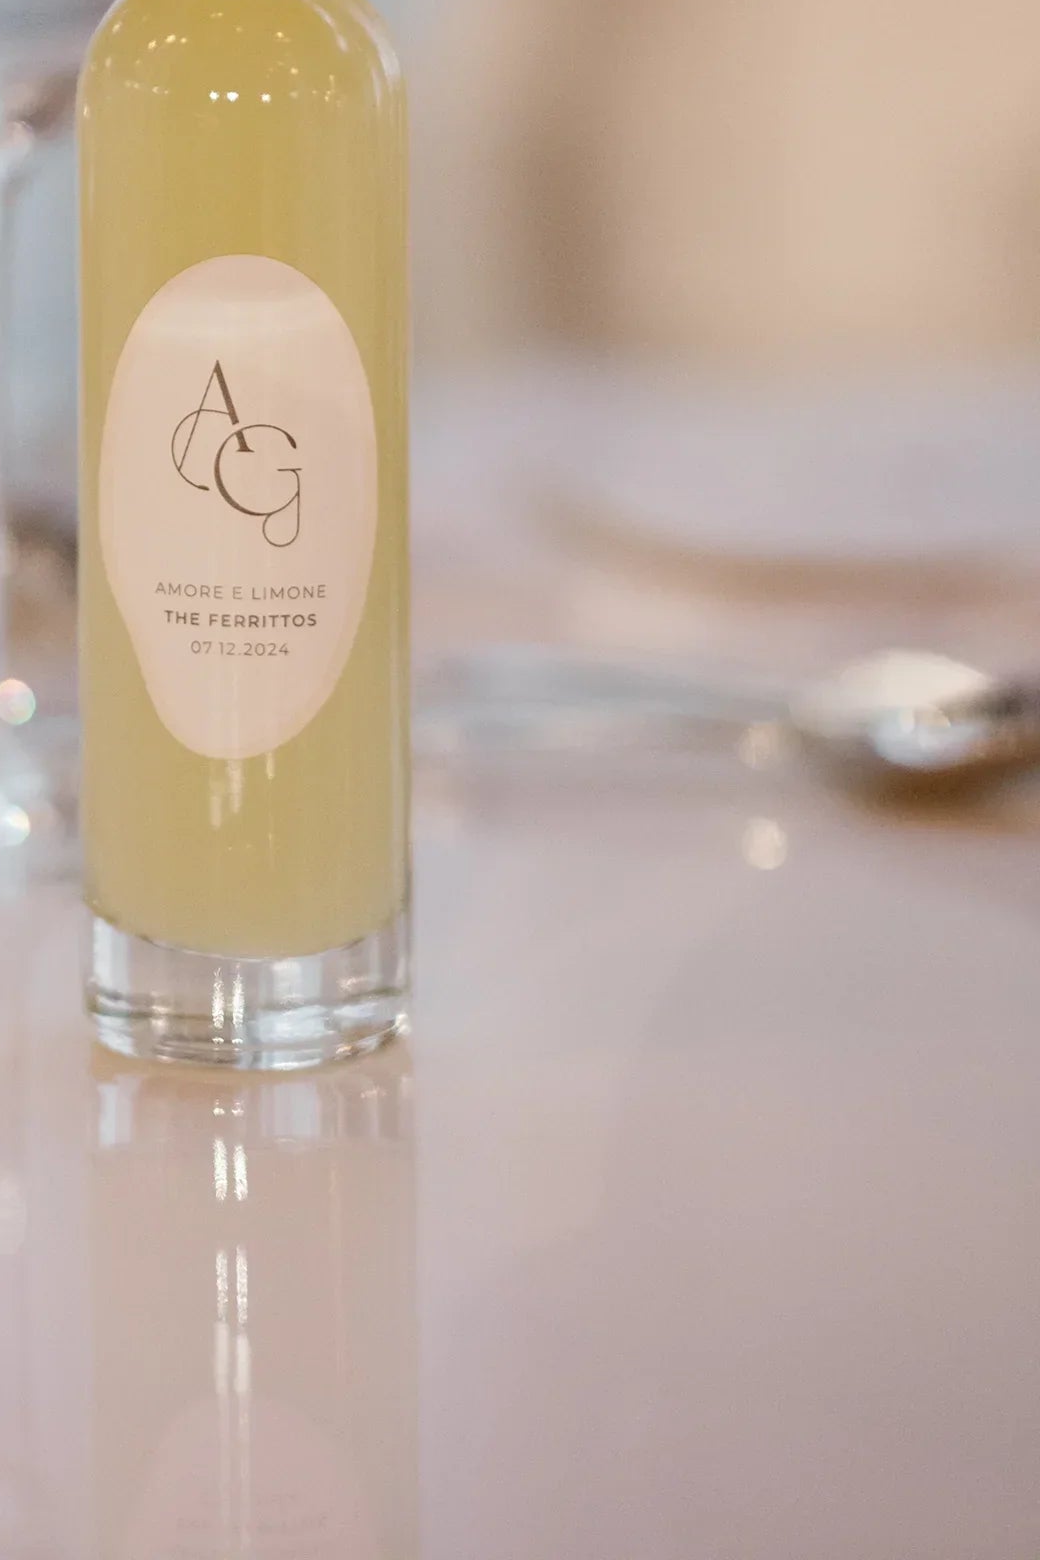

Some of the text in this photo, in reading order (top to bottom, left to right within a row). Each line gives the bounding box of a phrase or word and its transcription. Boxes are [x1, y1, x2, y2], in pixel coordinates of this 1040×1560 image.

[154, 581, 327, 600] AMORE E LIMONE
[164, 609, 317, 628] THE FERRITTOS
[190, 640, 290, 656] 0712.2024
